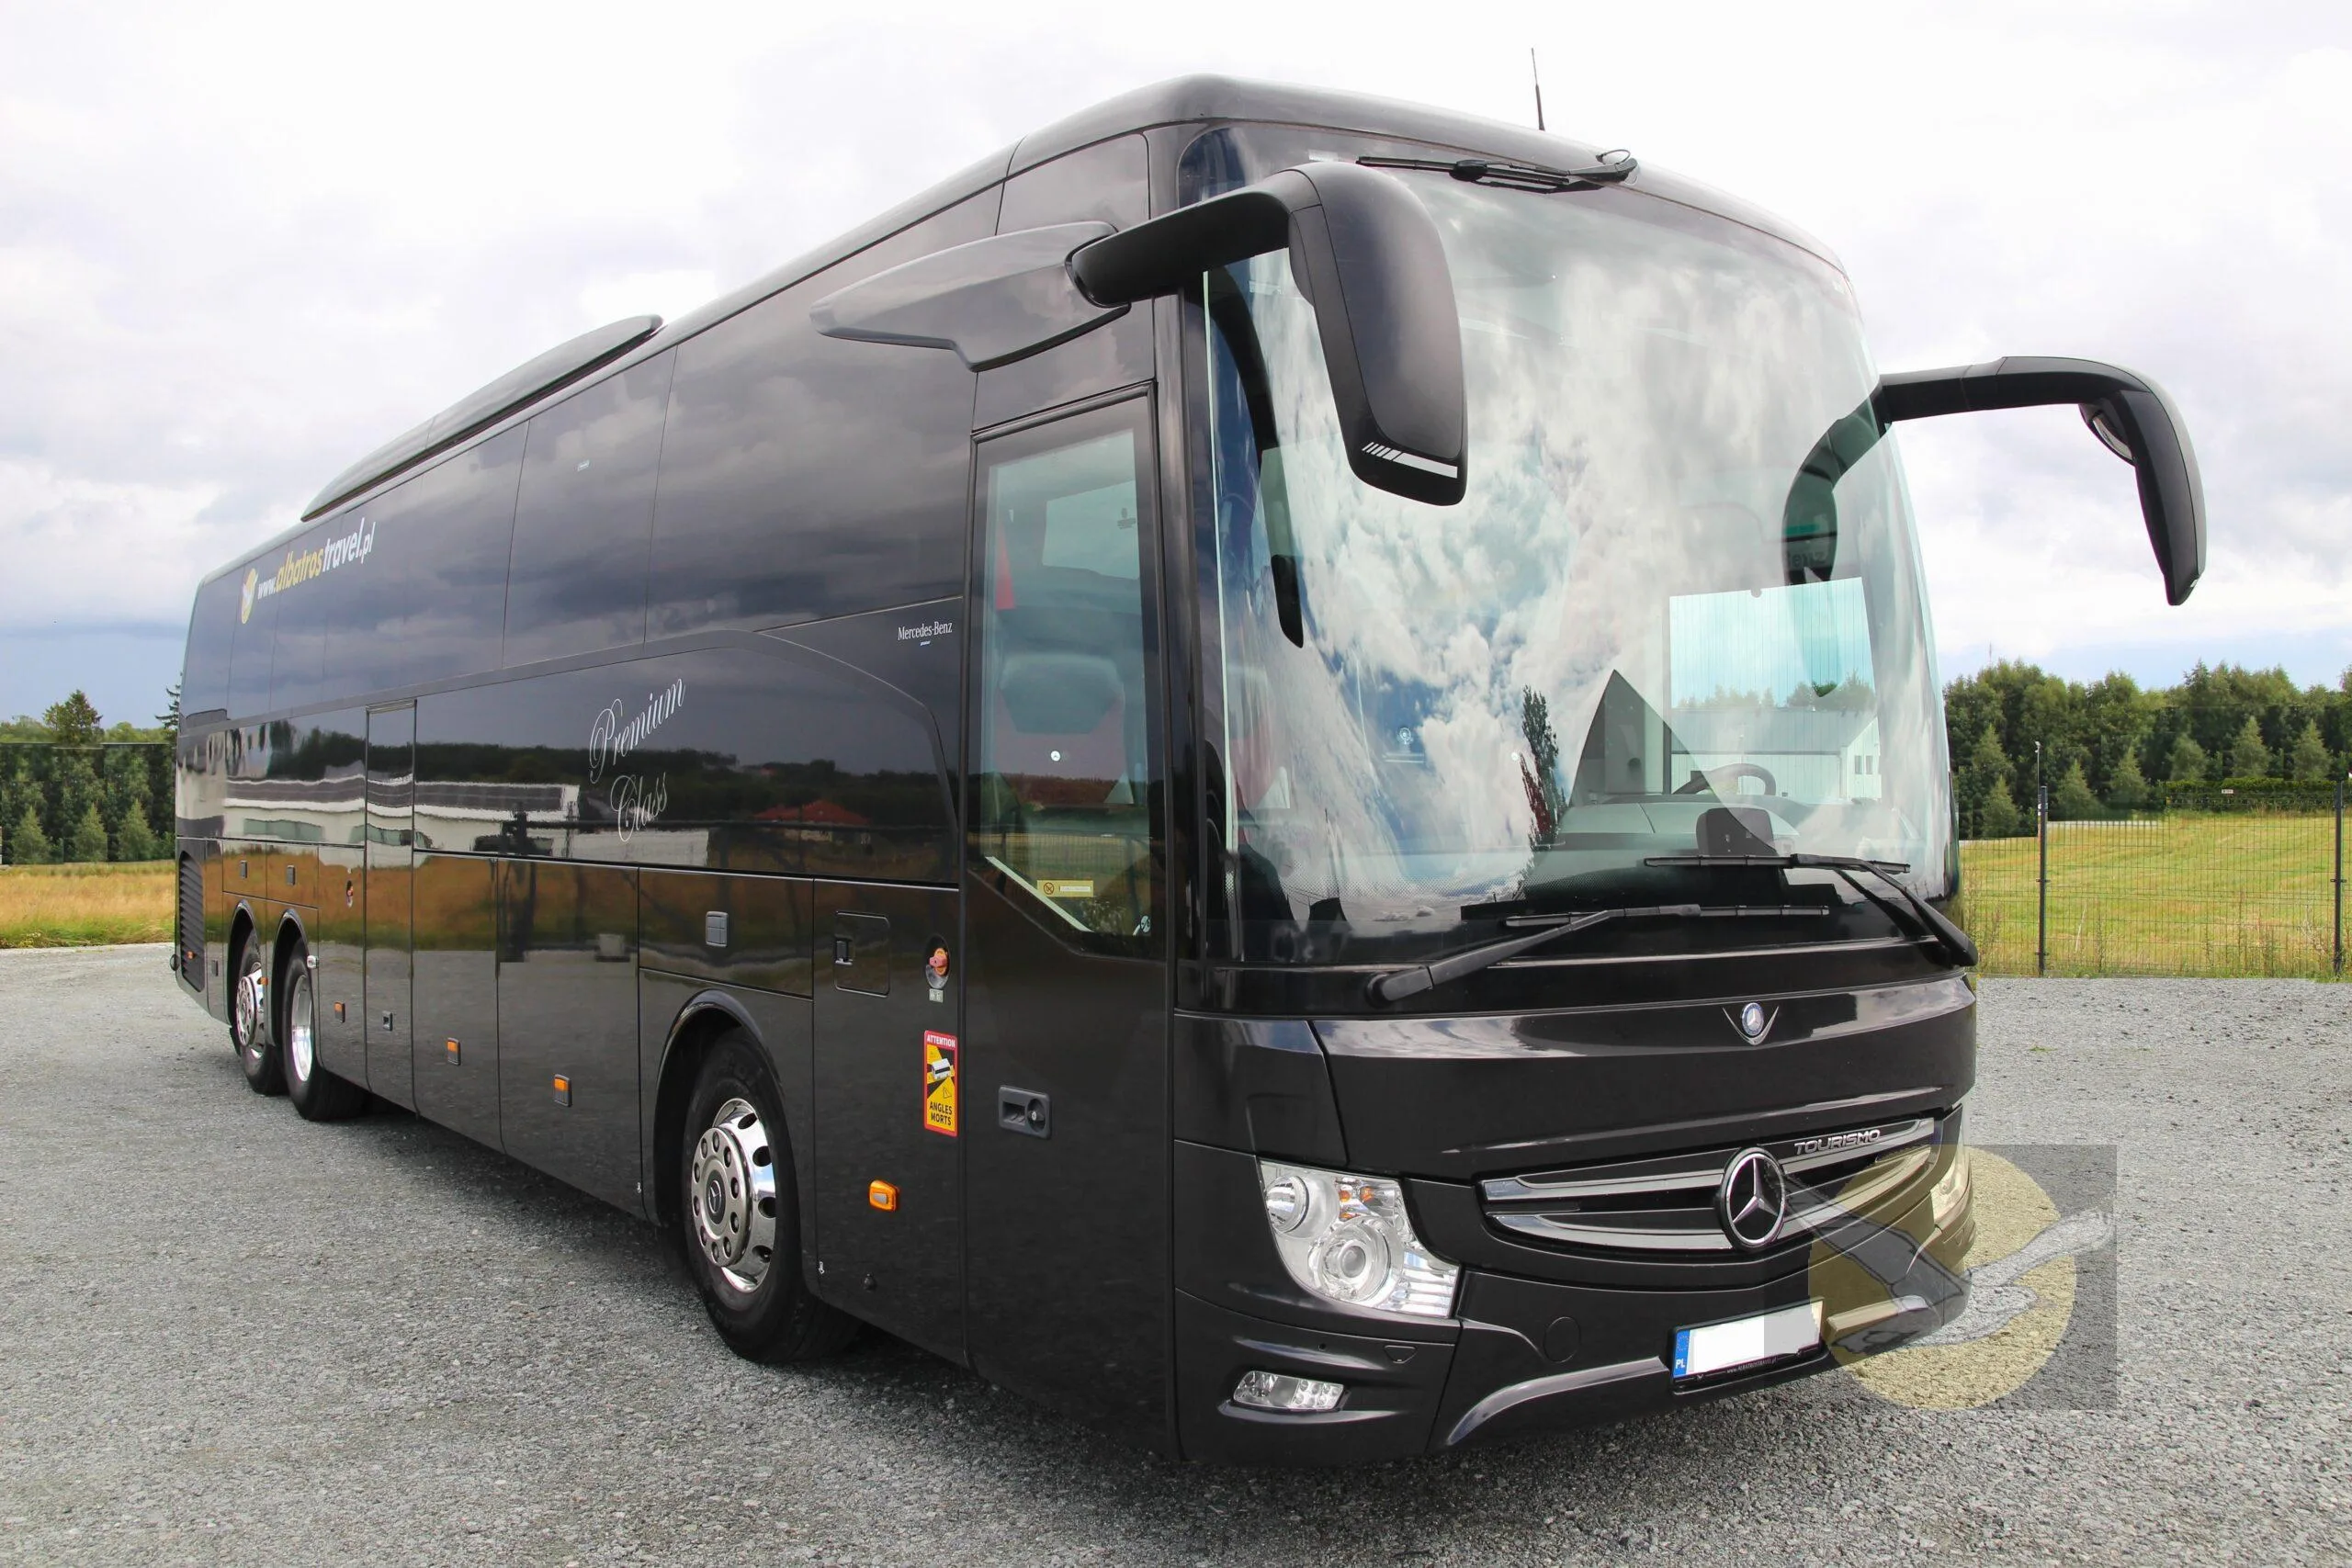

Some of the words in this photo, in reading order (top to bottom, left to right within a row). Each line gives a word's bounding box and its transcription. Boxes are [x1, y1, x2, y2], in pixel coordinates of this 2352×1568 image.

[258, 517, 376, 600] www.albatrostravel.pl
[898, 621, 953, 641] Mercedes-Benz
[589, 678, 686, 784] Premium
[610, 772, 668, 841] Class
[926, 1033, 956, 1048] ATTENTION
[929, 1101, 953, 1115] ANGLES
[931, 1112, 952, 1126] MORTS
[1794, 1129, 1881, 1156] TOURISMO
[1675, 1359, 1686, 1370] PL
